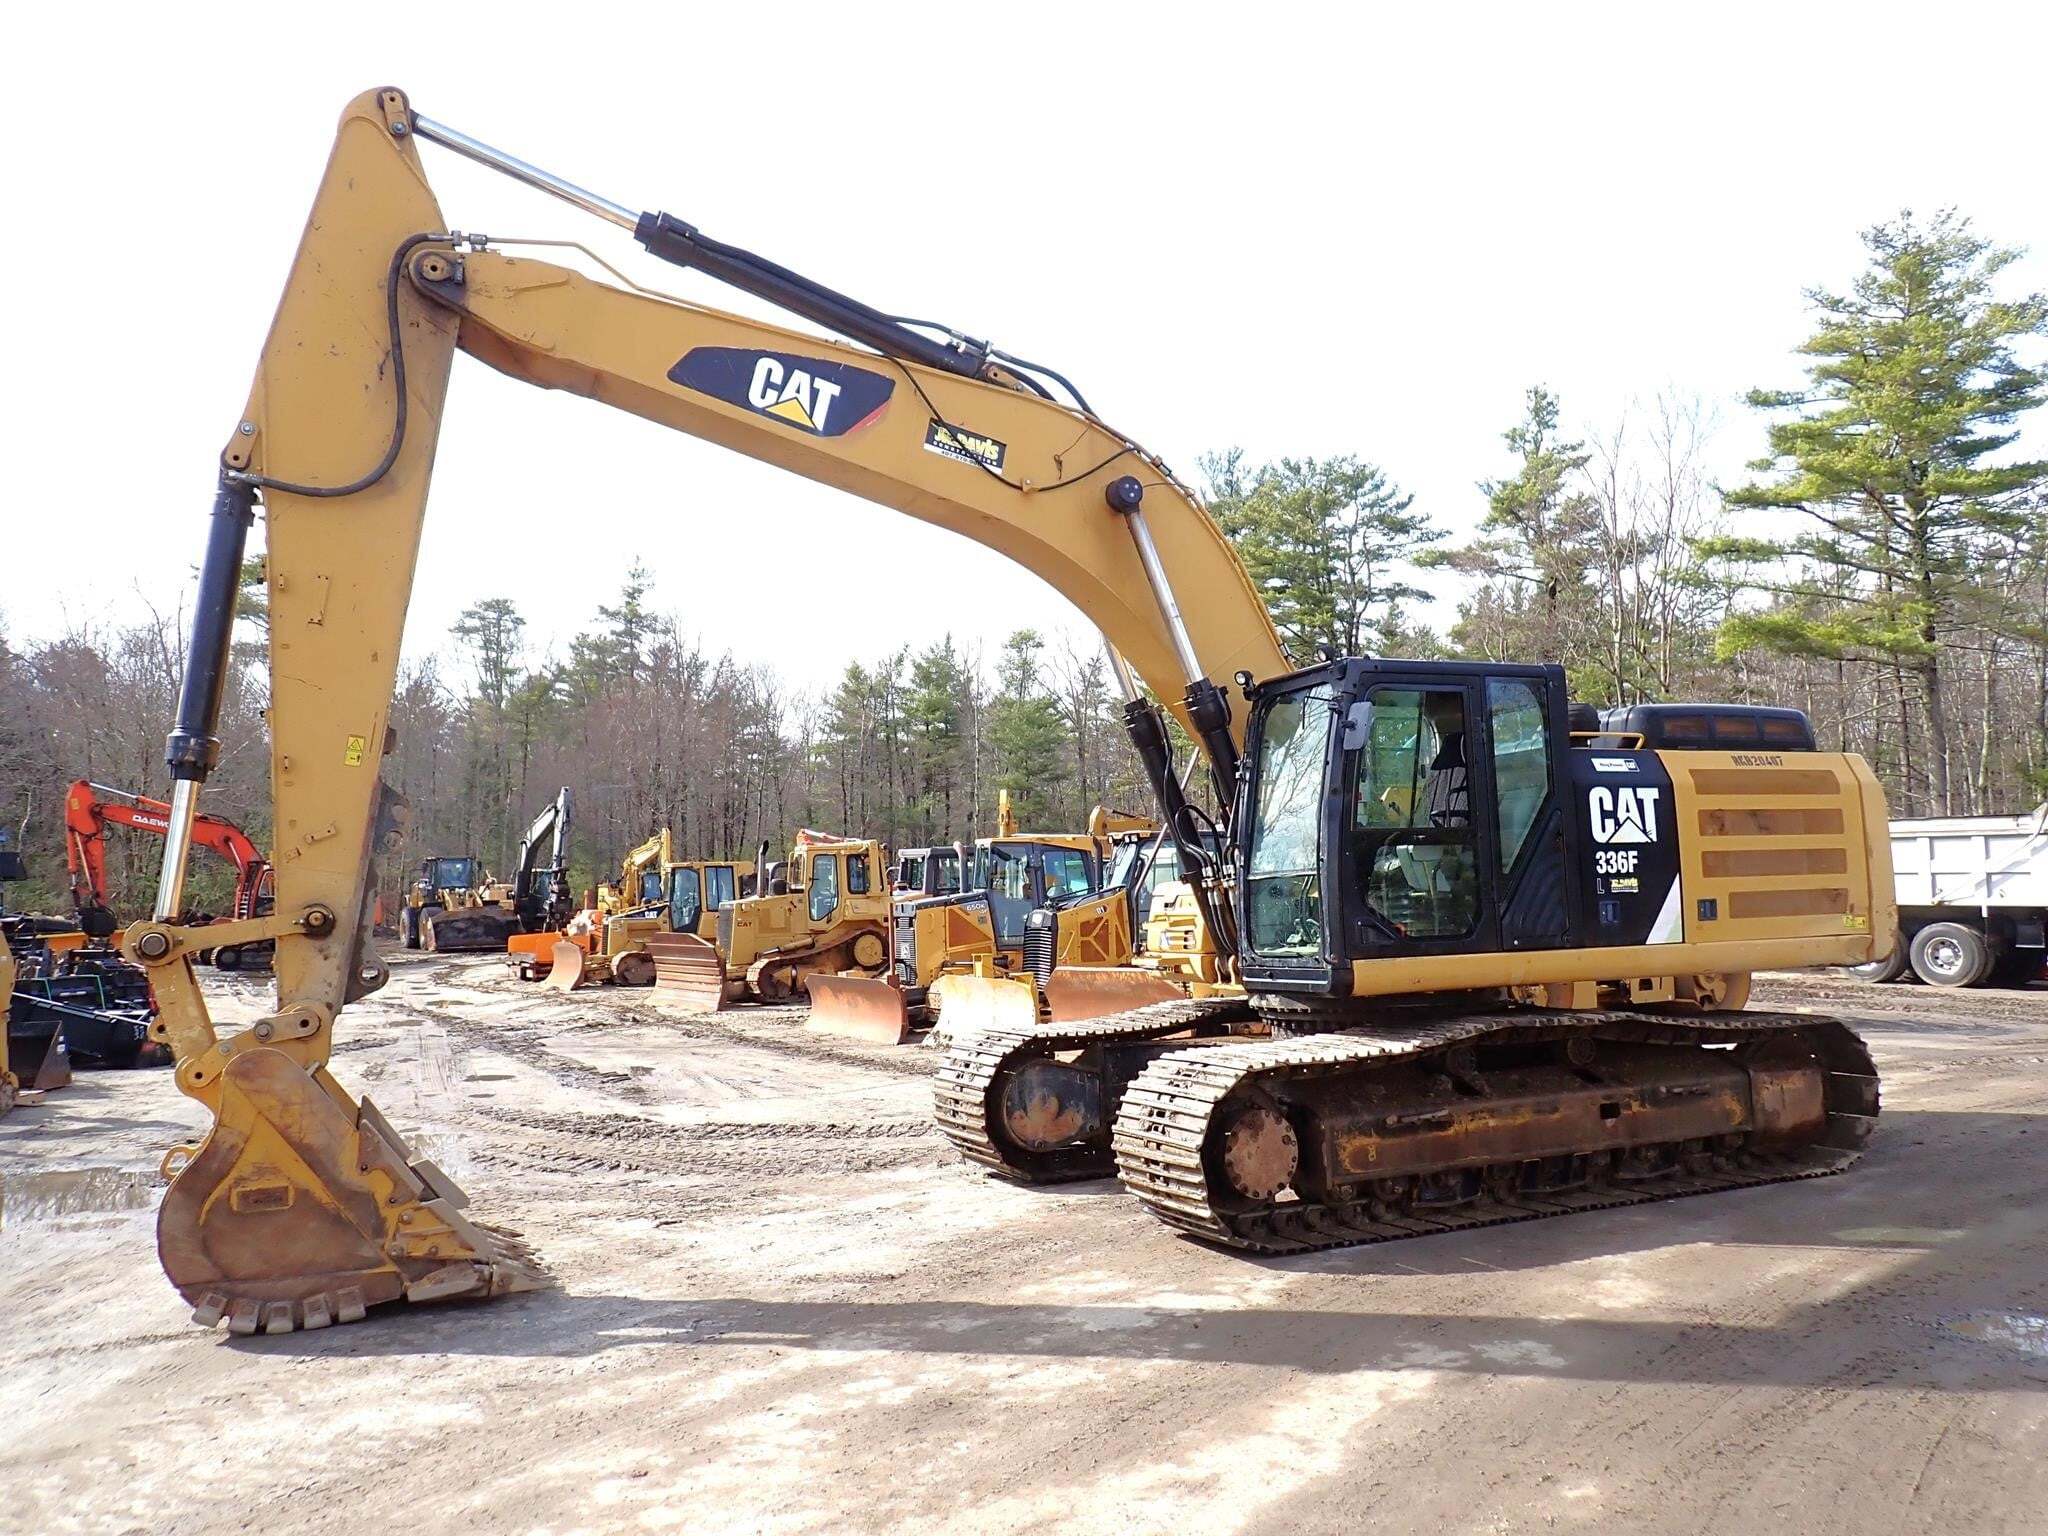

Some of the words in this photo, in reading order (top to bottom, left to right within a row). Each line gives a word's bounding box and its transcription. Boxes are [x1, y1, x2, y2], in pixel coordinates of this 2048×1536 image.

[748, 356, 841, 432] CAT
[1589, 787, 1660, 844] CAT
[1596, 850, 1638, 874] 336F
